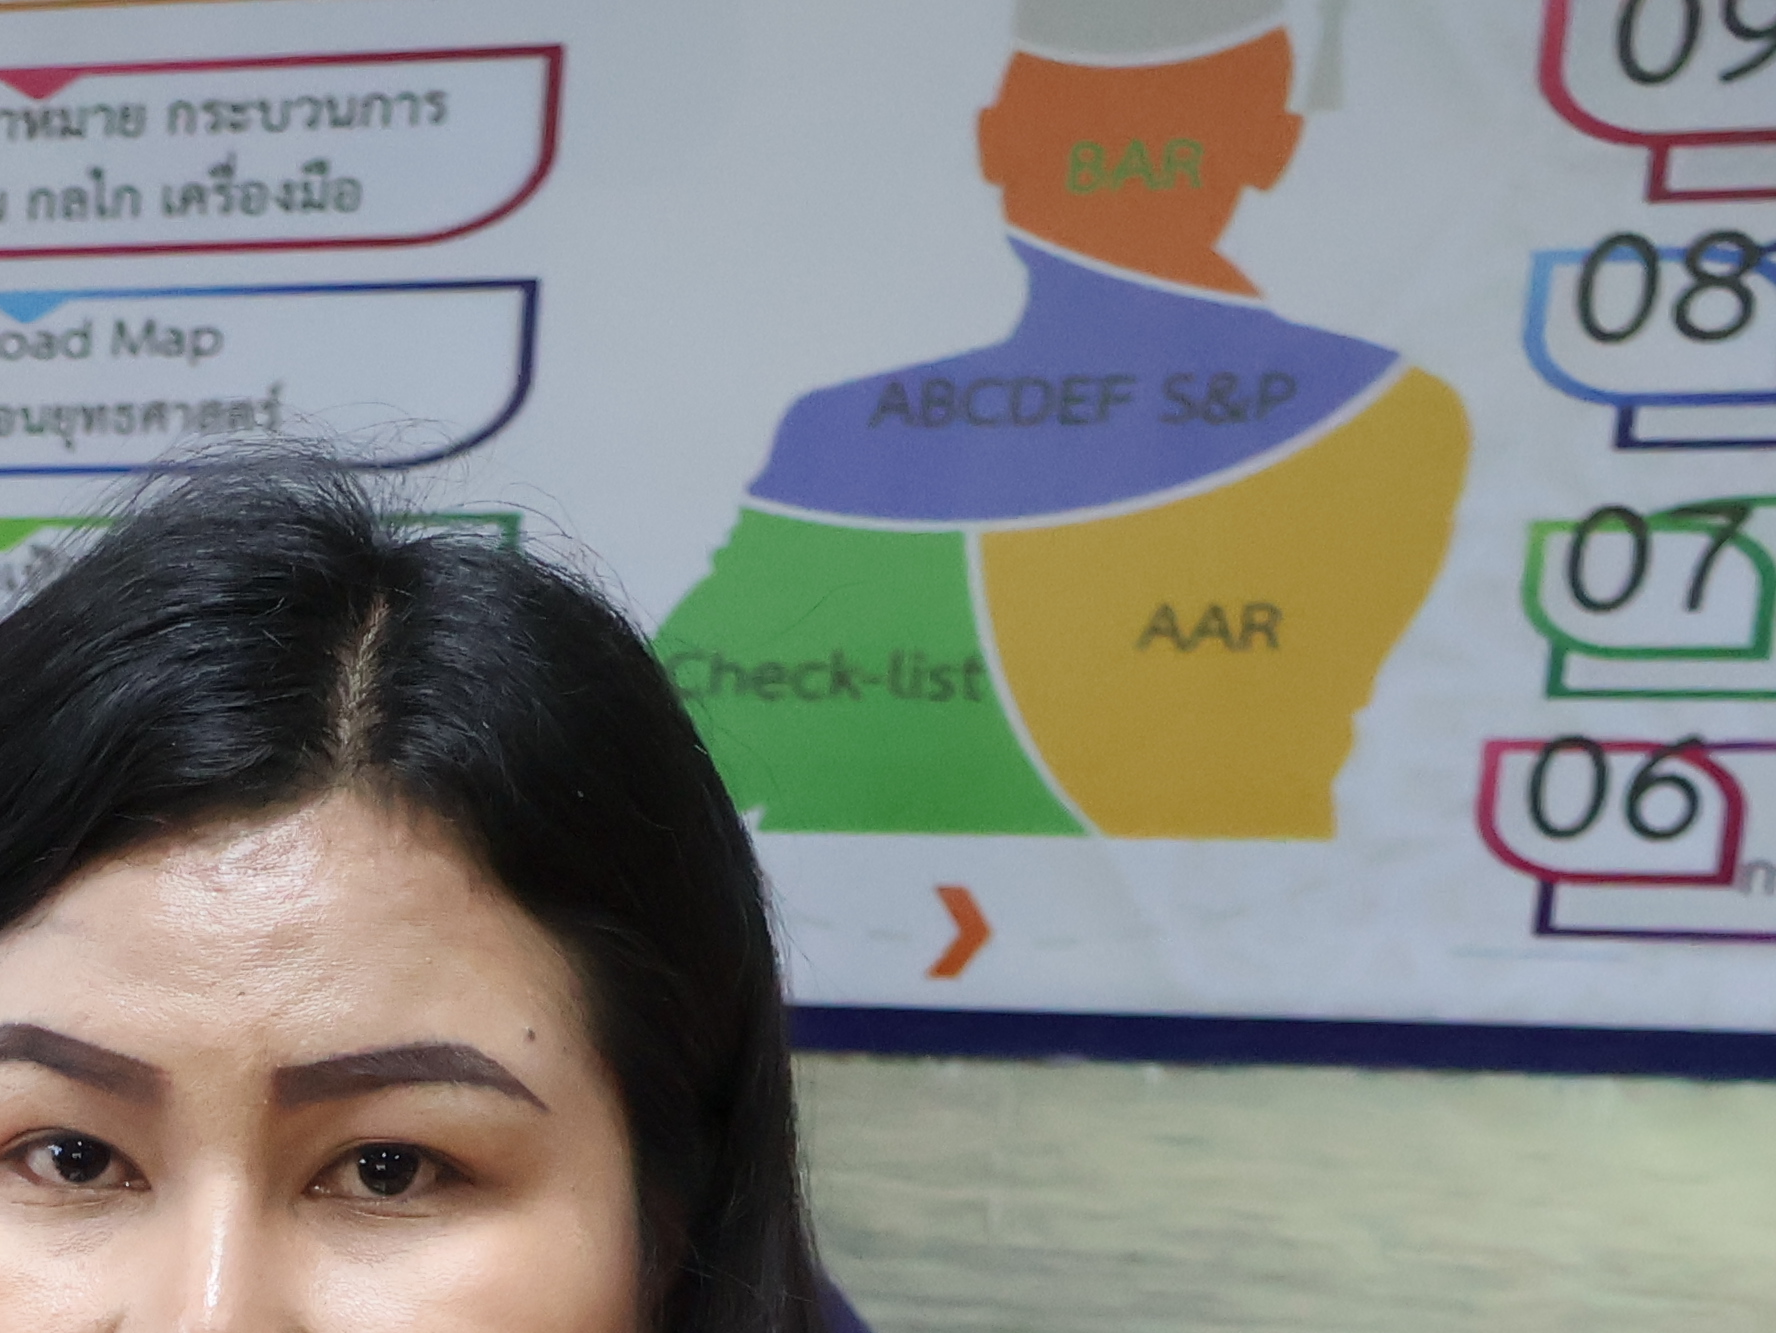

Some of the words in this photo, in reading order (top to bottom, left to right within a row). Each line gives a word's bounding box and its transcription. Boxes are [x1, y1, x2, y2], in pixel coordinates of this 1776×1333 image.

[167, 90, 448, 134] กระบวนการ
[27, 165, 142, 221] กลไก
[162, 152, 362, 216] เครื่องมือ
[1064, 138, 1206, 194] BAR
[1576, 232, 1758, 344] 08
[111, 318, 223, 362] Map
[868, 374, 1134, 430] ABCDEF
[1158, 372, 1298, 424] S&P
[1566, 504, 1752, 612] 07
[1136, 602, 1282, 652] AAR
[1528, 734, 1700, 842] 06
